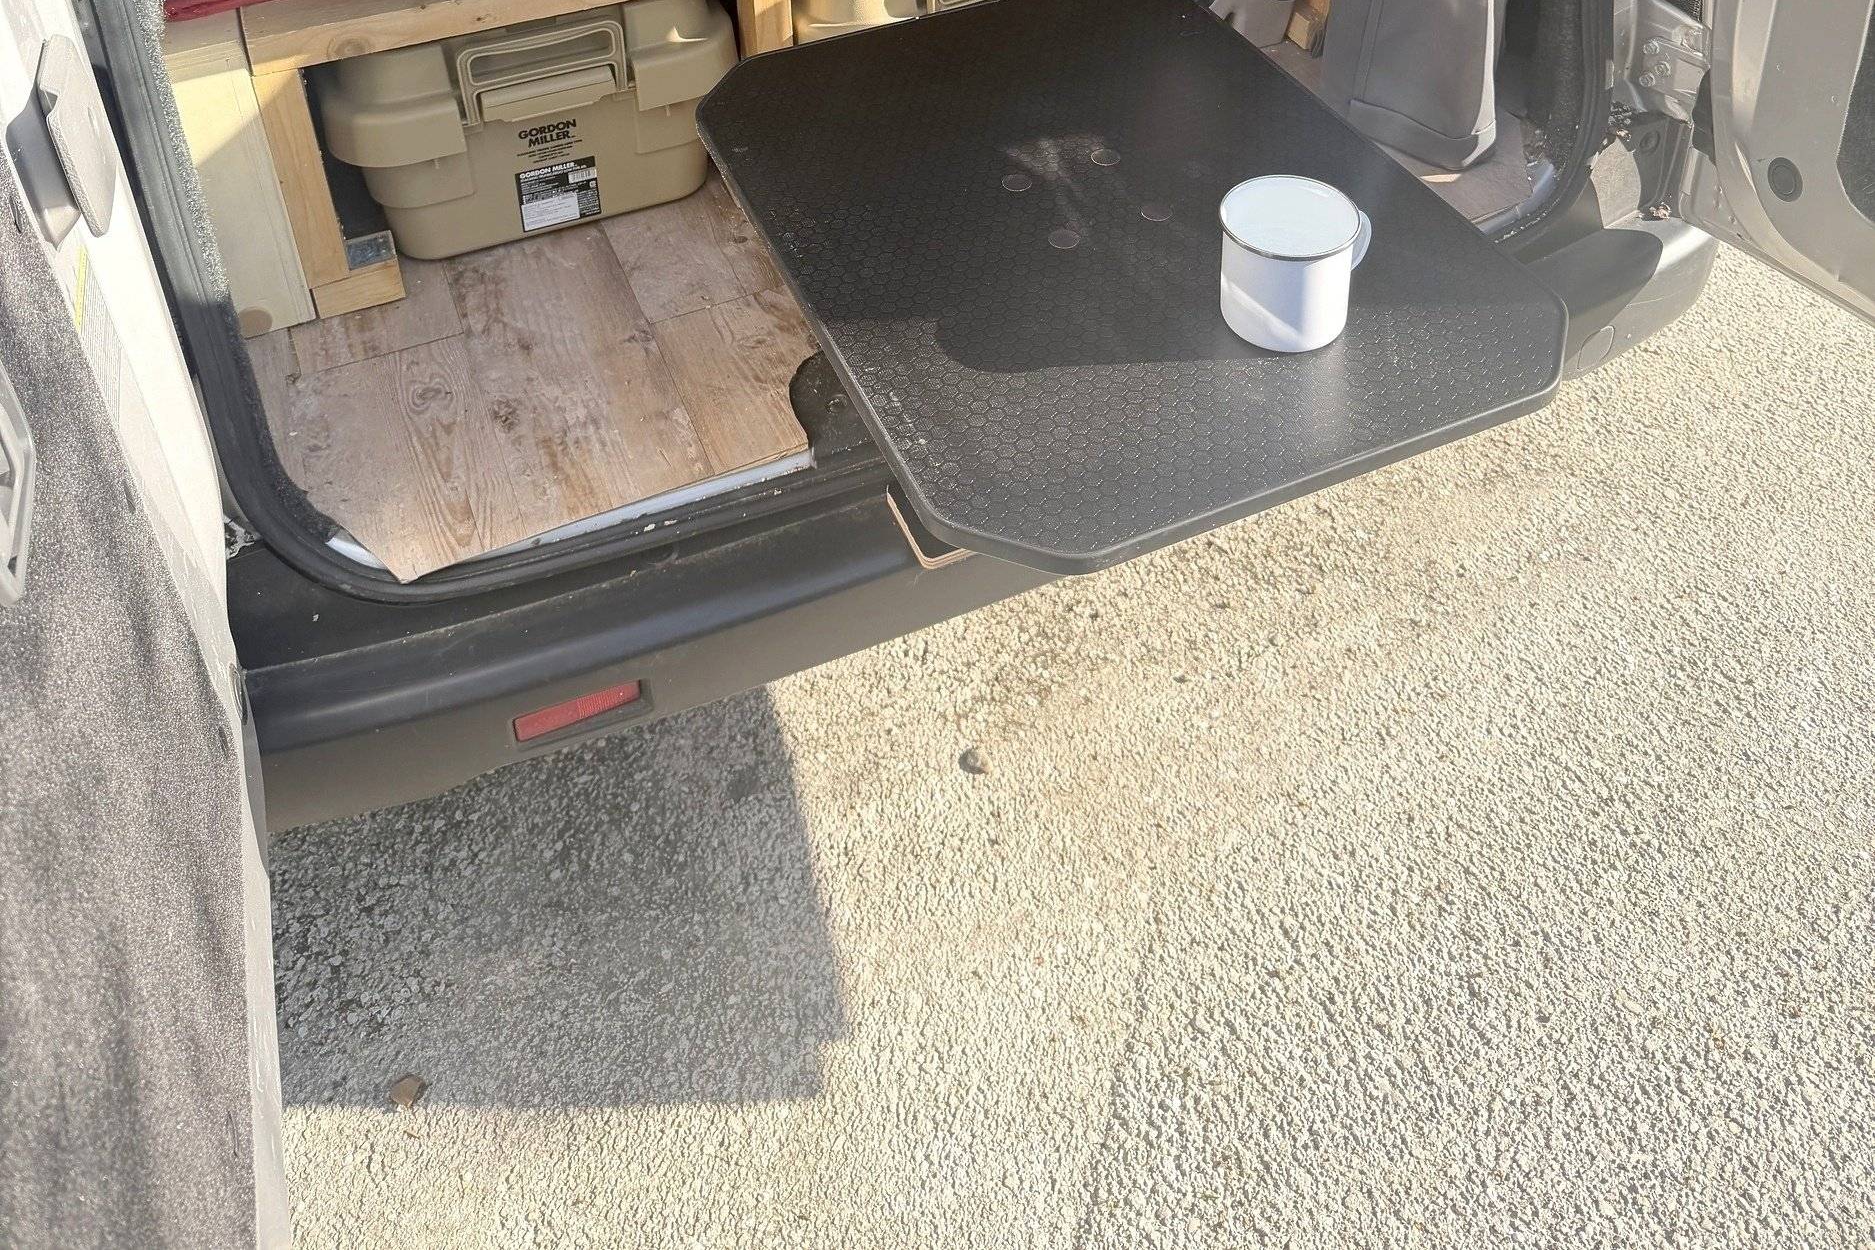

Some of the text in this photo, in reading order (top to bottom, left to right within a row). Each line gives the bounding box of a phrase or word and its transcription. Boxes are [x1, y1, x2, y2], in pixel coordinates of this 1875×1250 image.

[518, 119, 577, 139] GORDON
[528, 130, 571, 148] MILLER
[519, 167, 551, 179] GORDON
